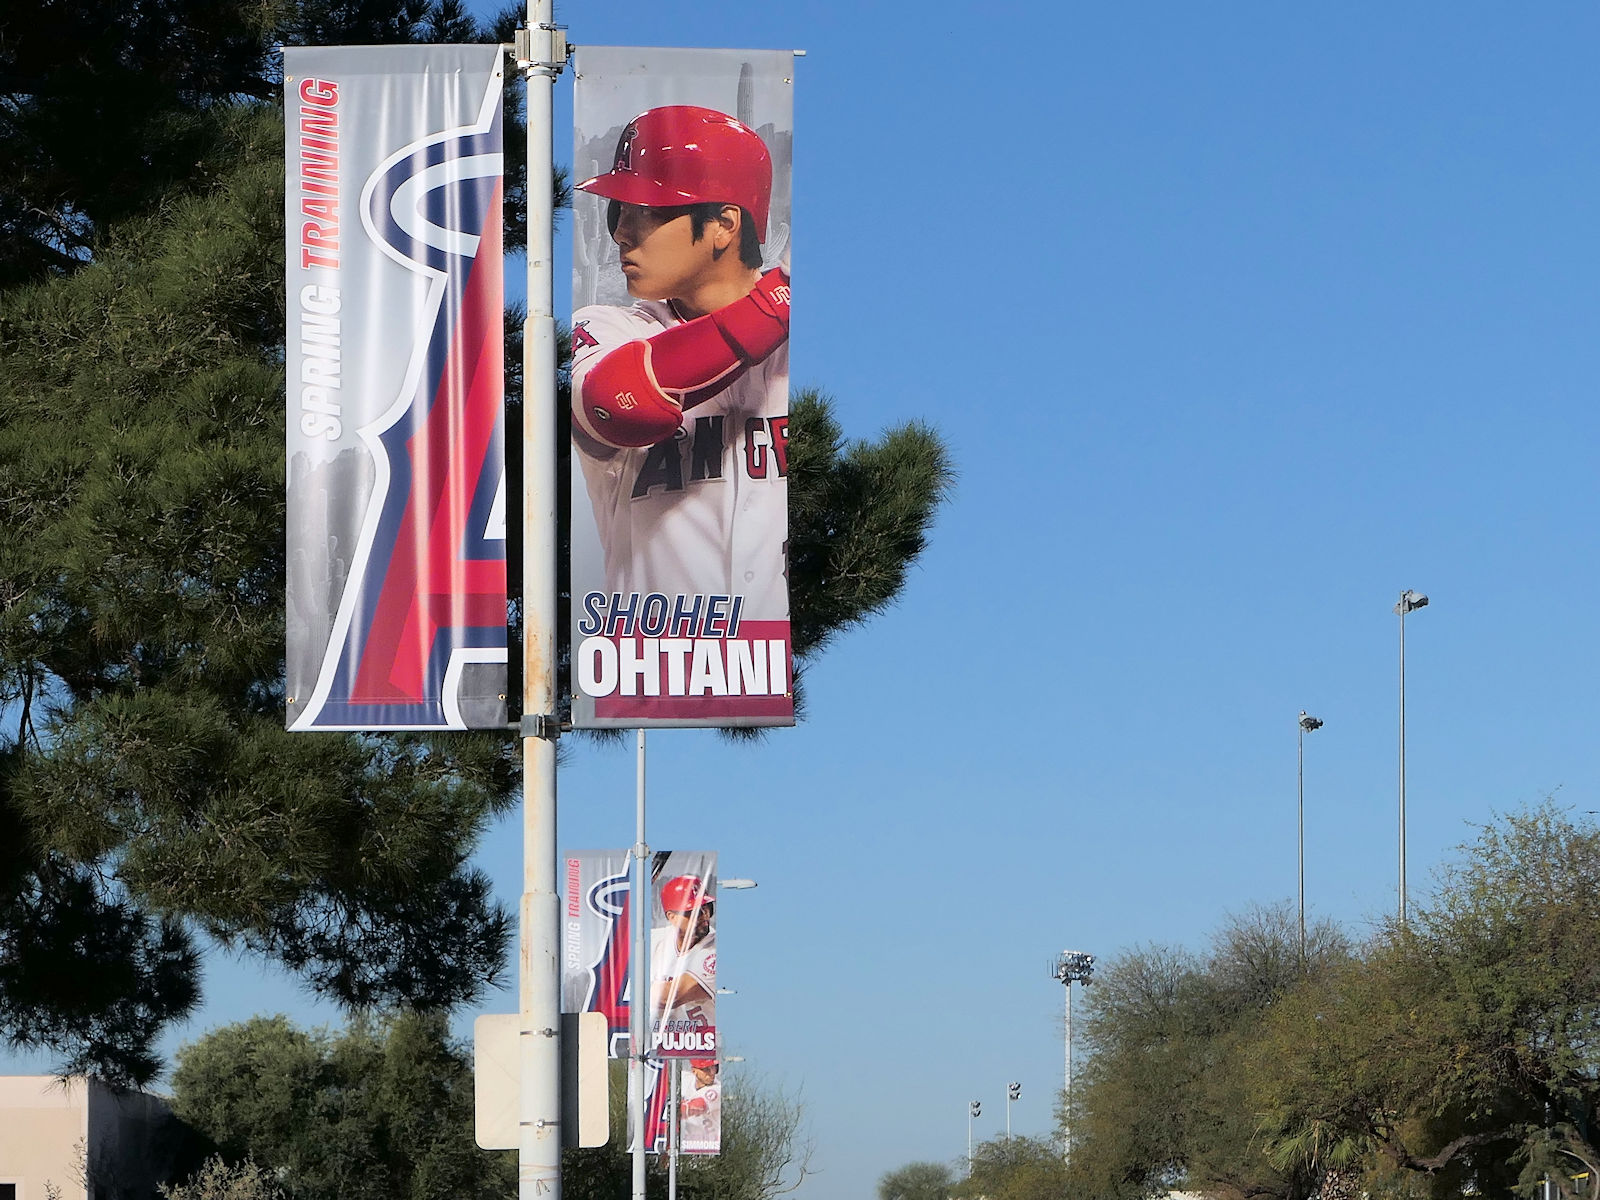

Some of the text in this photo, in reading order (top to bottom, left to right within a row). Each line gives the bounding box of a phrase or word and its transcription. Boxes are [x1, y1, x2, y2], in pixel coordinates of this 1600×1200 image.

[298, 77, 342, 441] SPRING TRAINING
[578, 591, 745, 639] SHOHEI
[578, 636, 788, 698] OHTANI
[567, 858, 581, 970] SPRING TRAINING
[652, 1032, 715, 1051] PUJOLS
